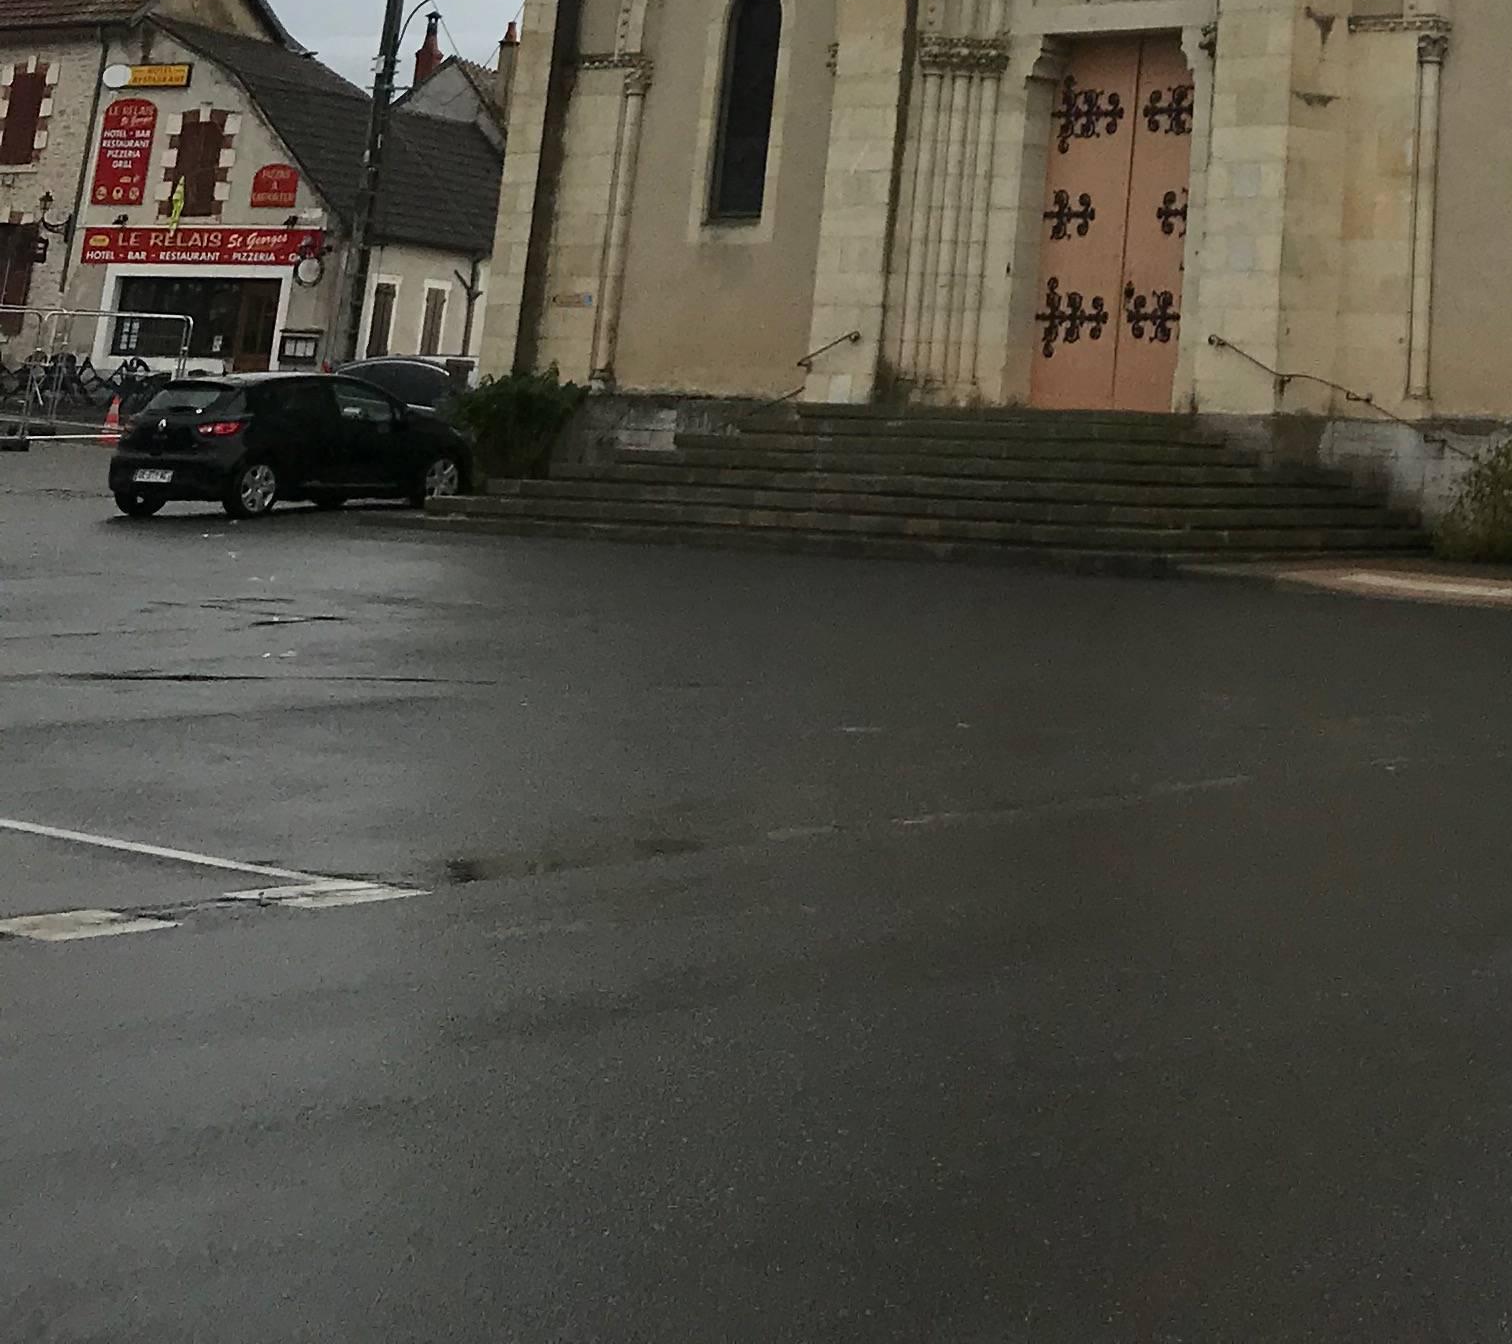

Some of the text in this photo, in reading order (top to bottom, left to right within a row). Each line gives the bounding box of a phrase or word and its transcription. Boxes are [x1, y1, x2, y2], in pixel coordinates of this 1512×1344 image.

[103, 129, 127, 139] HOTEL
[135, 129, 151, 138] BAR
[102, 139, 150, 148] RESTAURANT
[106, 149, 141, 159] PIZZERIA
[118, 232, 142, 247] LE
[149, 231, 222, 248] RELAIS
[227, 233, 243, 249] St
[246, 231, 288, 250] Georges
[86, 250, 115, 260] HOTEL
[127, 251, 147, 261] BAR
[159, 251, 220, 261] RESTAURANT
[231, 252, 276, 262] PIZZERIA
